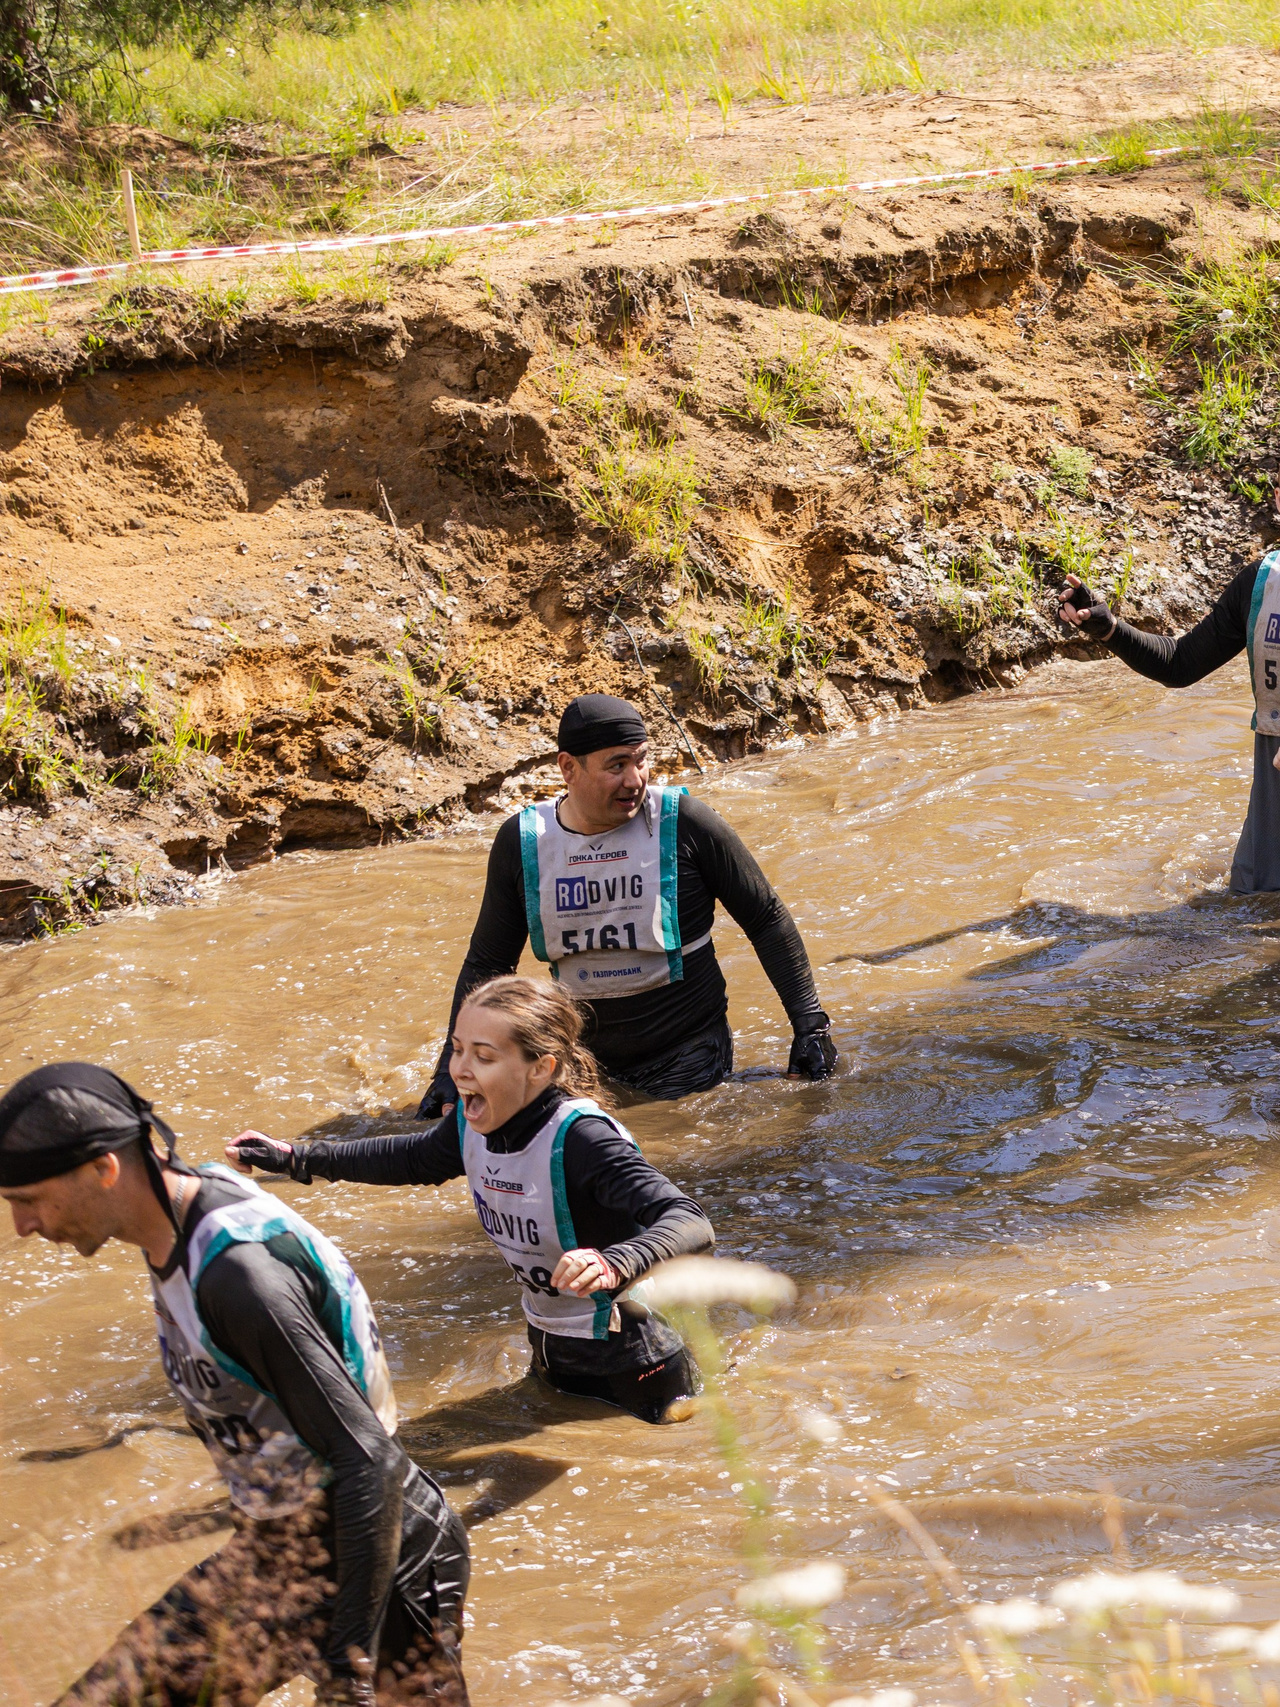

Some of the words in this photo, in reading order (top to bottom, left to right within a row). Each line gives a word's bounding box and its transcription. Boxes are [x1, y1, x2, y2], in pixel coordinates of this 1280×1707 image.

[568, 854, 593, 863] ГОНКА
[595, 850, 628, 861] ГЕРОЕВ
[558, 874, 643, 907] RODVIG
[561, 922, 638, 957] 5161
[592, 966, 642, 978] ГАЗПРОМБАНК
[491, 1179, 524, 1192] ГЕРОЕВ
[478, 1202, 541, 1246] ODVIG
